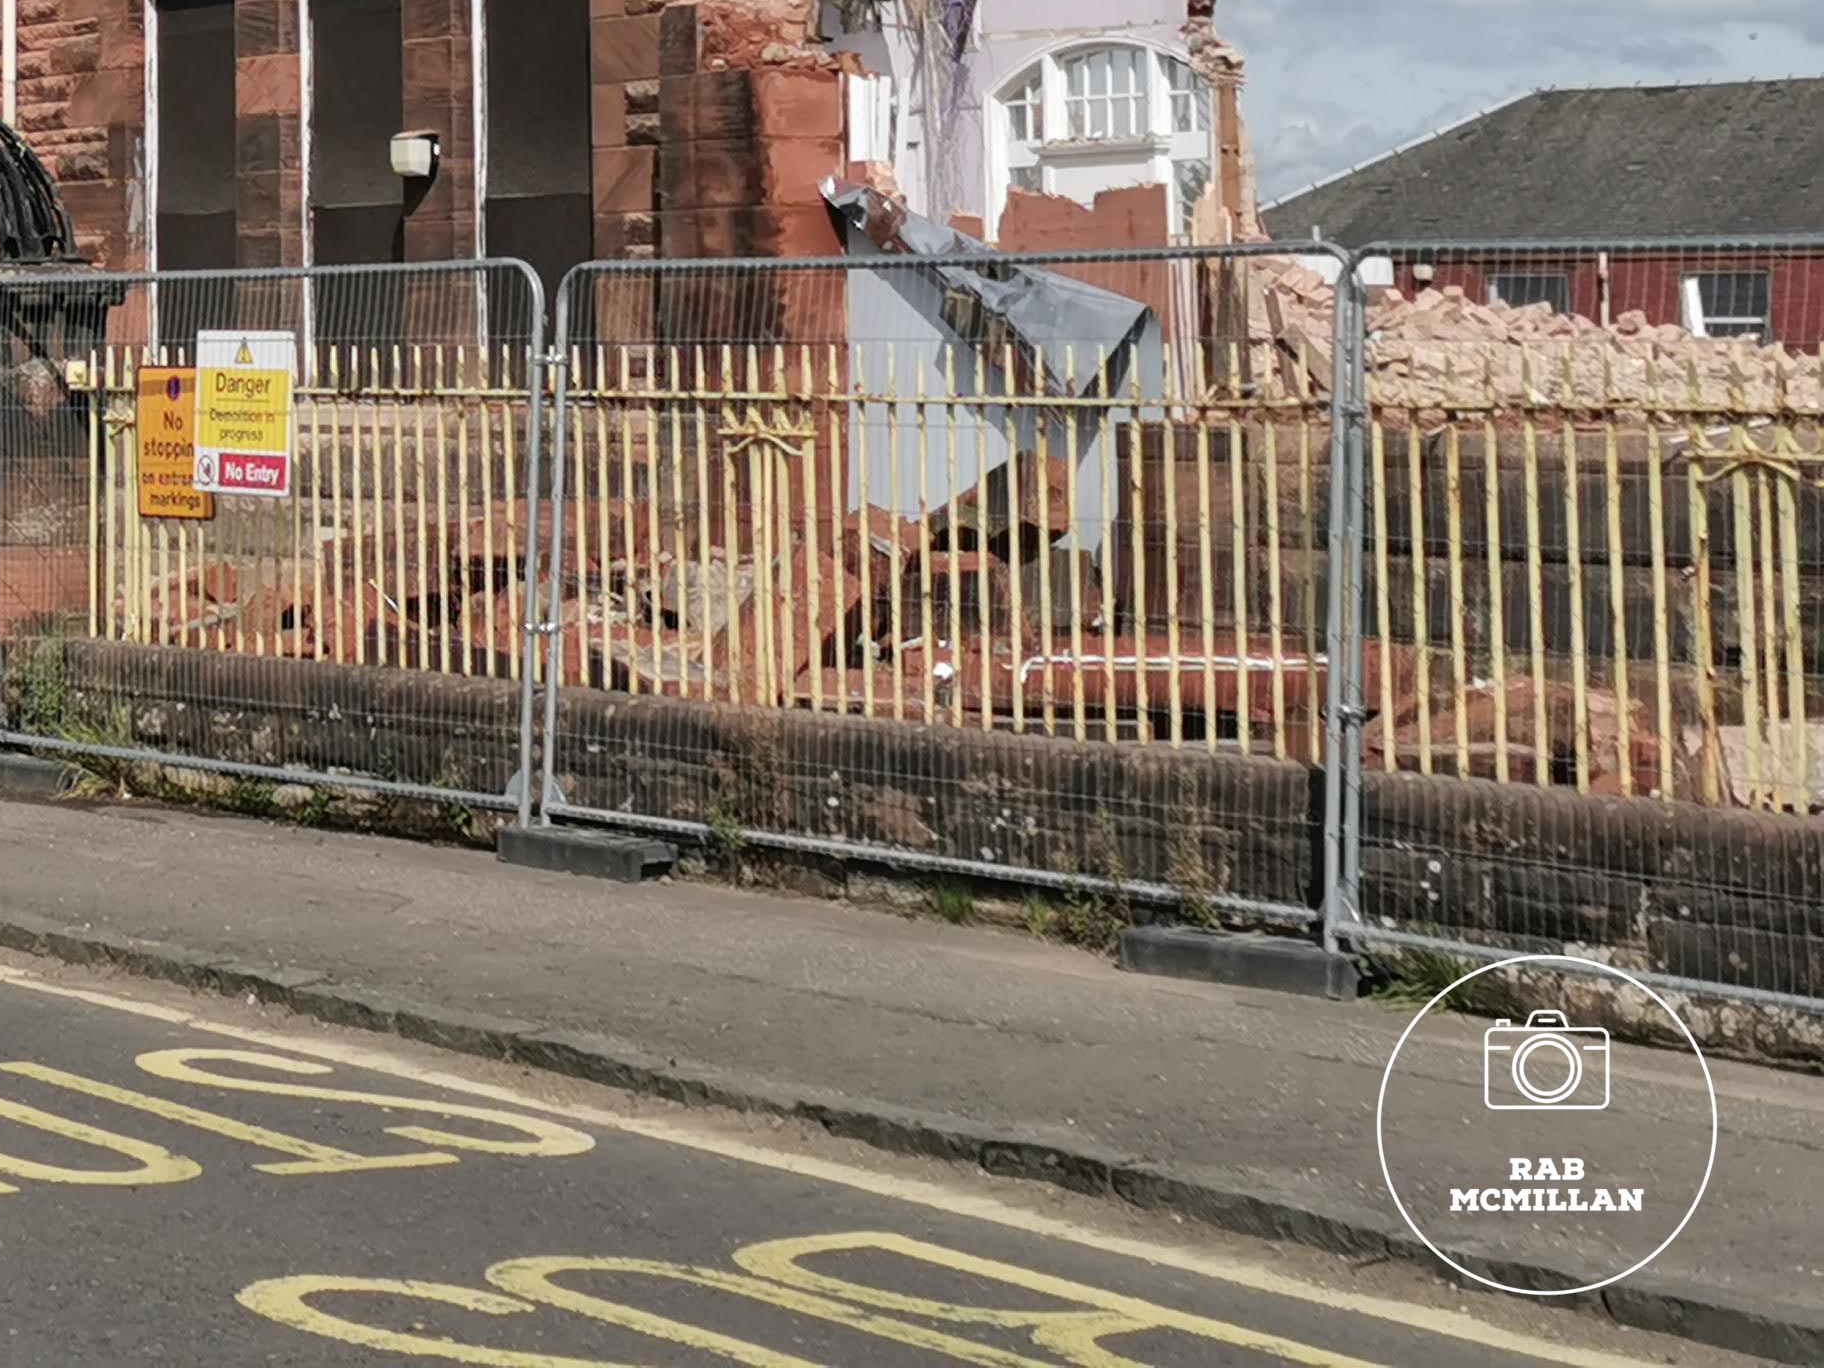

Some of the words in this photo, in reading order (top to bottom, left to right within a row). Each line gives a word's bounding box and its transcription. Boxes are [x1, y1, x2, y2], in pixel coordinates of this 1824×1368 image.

[215, 372, 272, 398] Danger
[163, 411, 183, 431] No
[210, 408, 262, 422] Demolition
[265, 409, 275, 424] in
[144, 437, 194, 461] stoppin
[142, 473, 155, 484] on
[225, 461, 243, 481] No
[245, 463, 280, 486] Entry
[150, 493, 201, 511] markings
